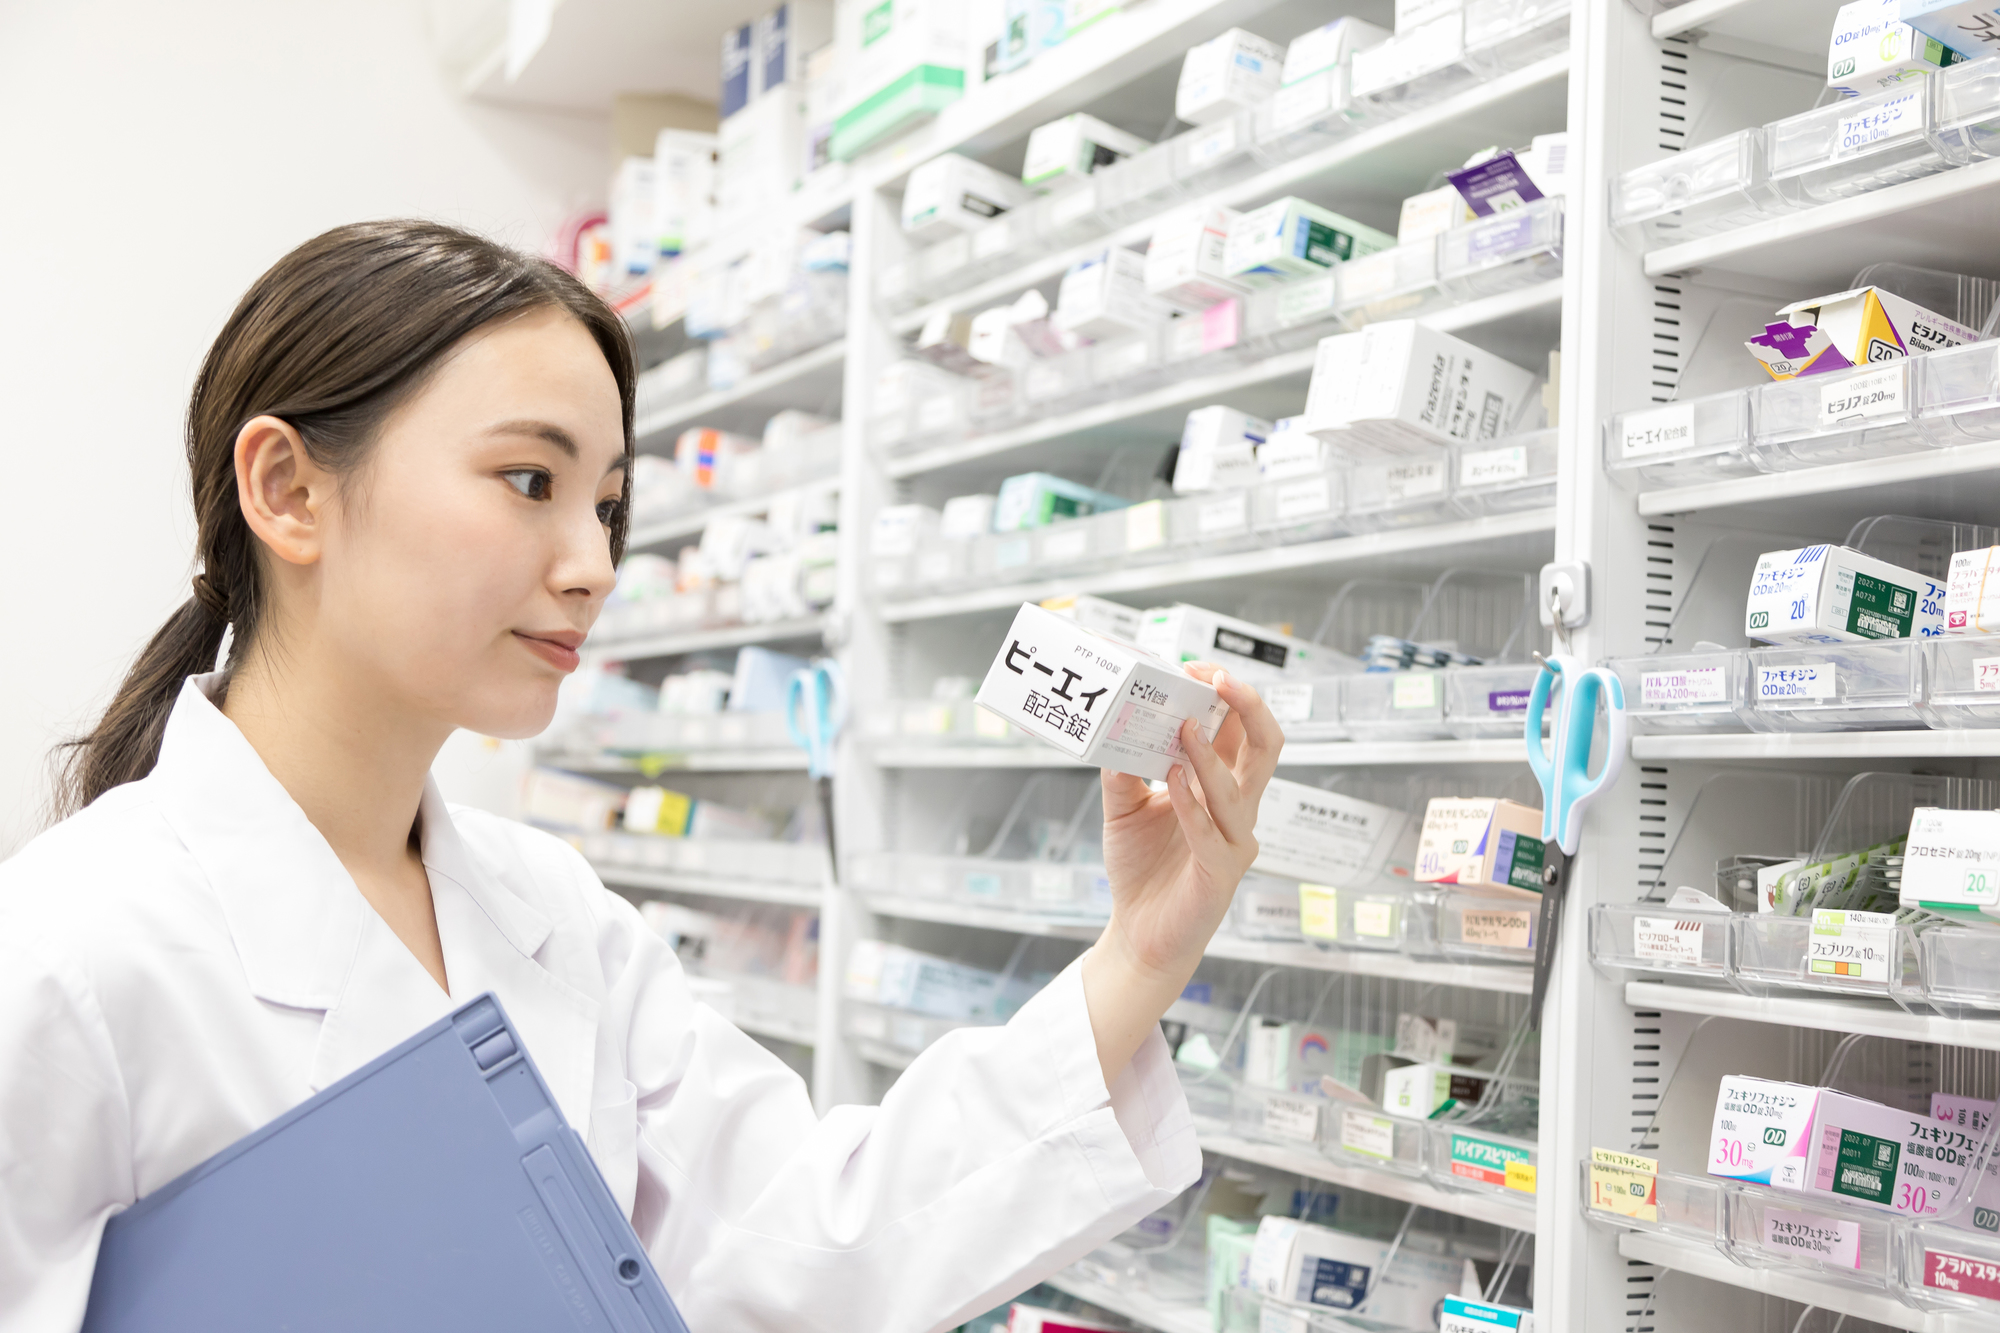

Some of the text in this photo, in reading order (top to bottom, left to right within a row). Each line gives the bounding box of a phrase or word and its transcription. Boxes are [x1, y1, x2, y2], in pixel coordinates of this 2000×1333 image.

[1834, 58, 1854, 77] OD
[1843, 108, 1903, 135] ファモチジン
[1843, 127, 1890, 148] OD錠10mg
[1874, 346, 1893, 361] 20
[1775, 363, 1787, 372] 20
[1419, 352, 1446, 424] Trazenta
[1757, 567, 1806, 583] ファモチジン
[1857, 576, 1887, 593] 2022.12
[1855, 590, 1876, 603] A0728
[1790, 599, 1805, 620] 20
[1921, 599, 1945, 620] 20m
[1751, 612, 1768, 627] OD
[1074, 645, 1121, 676] PTP 100錠
[1005, 639, 1108, 712] ピーエイ
[1762, 668, 1818, 683] ファモチジン
[1129, 679, 1169, 706] ピーエイ配合錠
[1762, 683, 1807, 696] OD錠20mg
[1022, 689, 1091, 742] 配合錠
[1812, 941, 1886, 962] フェブリク錠10mg
[1727, 1088, 1798, 1108] フェキソフェナジン
[1724, 1102, 1783, 1120] 塩酸塩OD錠30mg
[1936, 1104, 1954, 1121] 3
[1765, 1128, 1785, 1146] OD
[1843, 1133, 1871, 1147] 2022.07
[1716, 1138, 1754, 1170] 30mg
[1630, 1184, 1644, 1196] OD
[1896, 1183, 1938, 1215] 30mg
[1975, 1210, 1999, 1228] OD
[1771, 1219, 1842, 1242] フェキソフェナジン
[1934, 1271, 1959, 1291] 10mg
